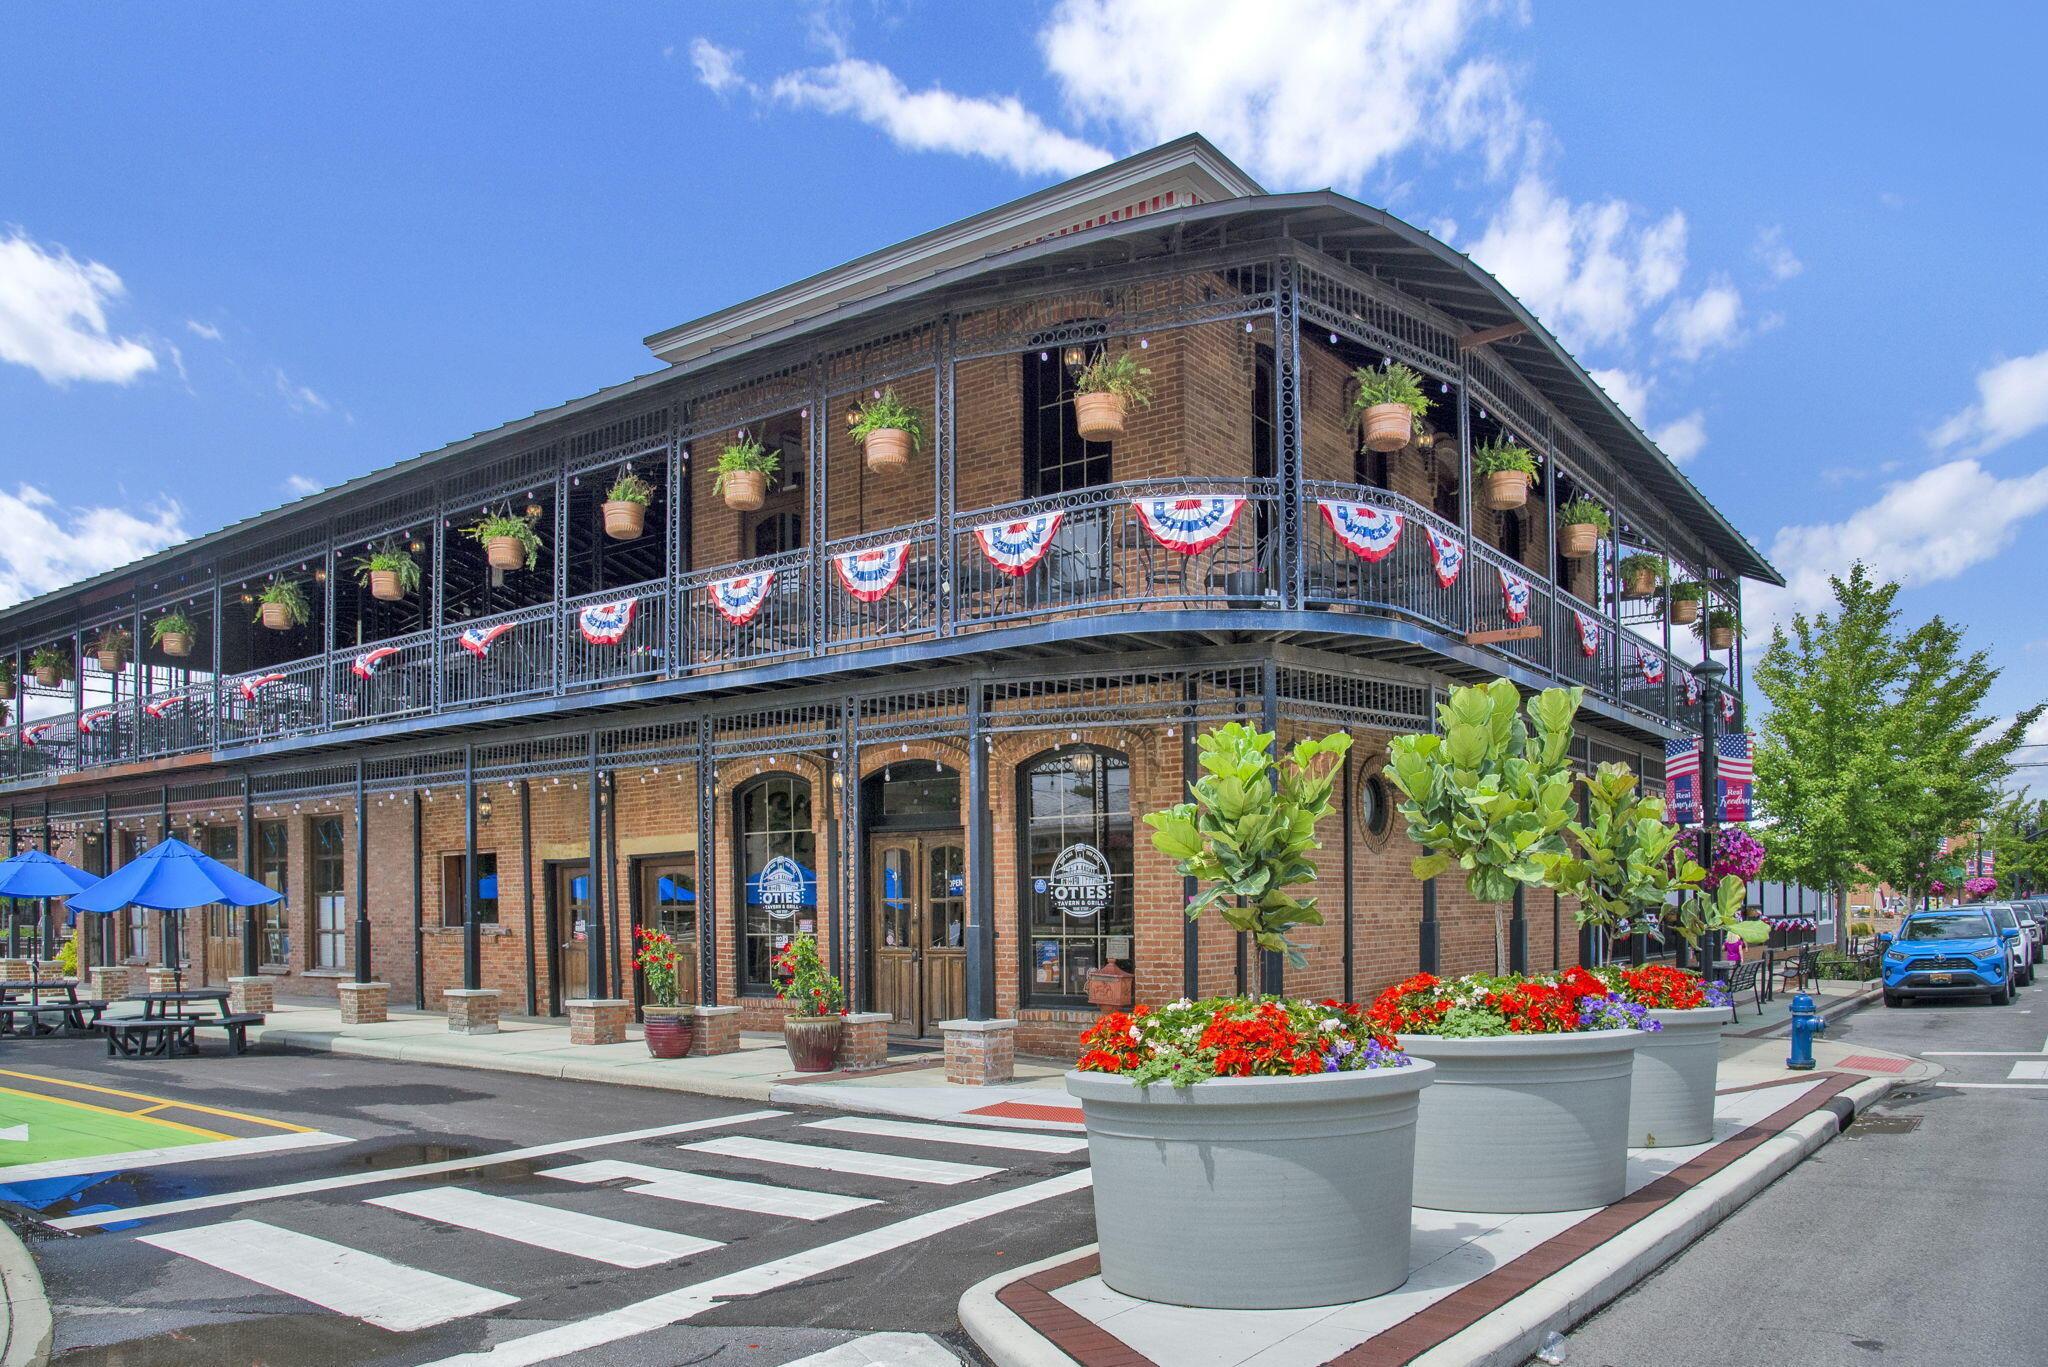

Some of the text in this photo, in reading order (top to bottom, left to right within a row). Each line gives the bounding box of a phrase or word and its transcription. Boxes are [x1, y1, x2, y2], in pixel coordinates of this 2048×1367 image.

[1669, 799, 1698, 810] America
[1720, 795, 1751, 808] Freedom
[949, 879, 963, 887] OPEN
[762, 892, 801, 904] OTIES
[1054, 886, 1107, 900] OTIES
